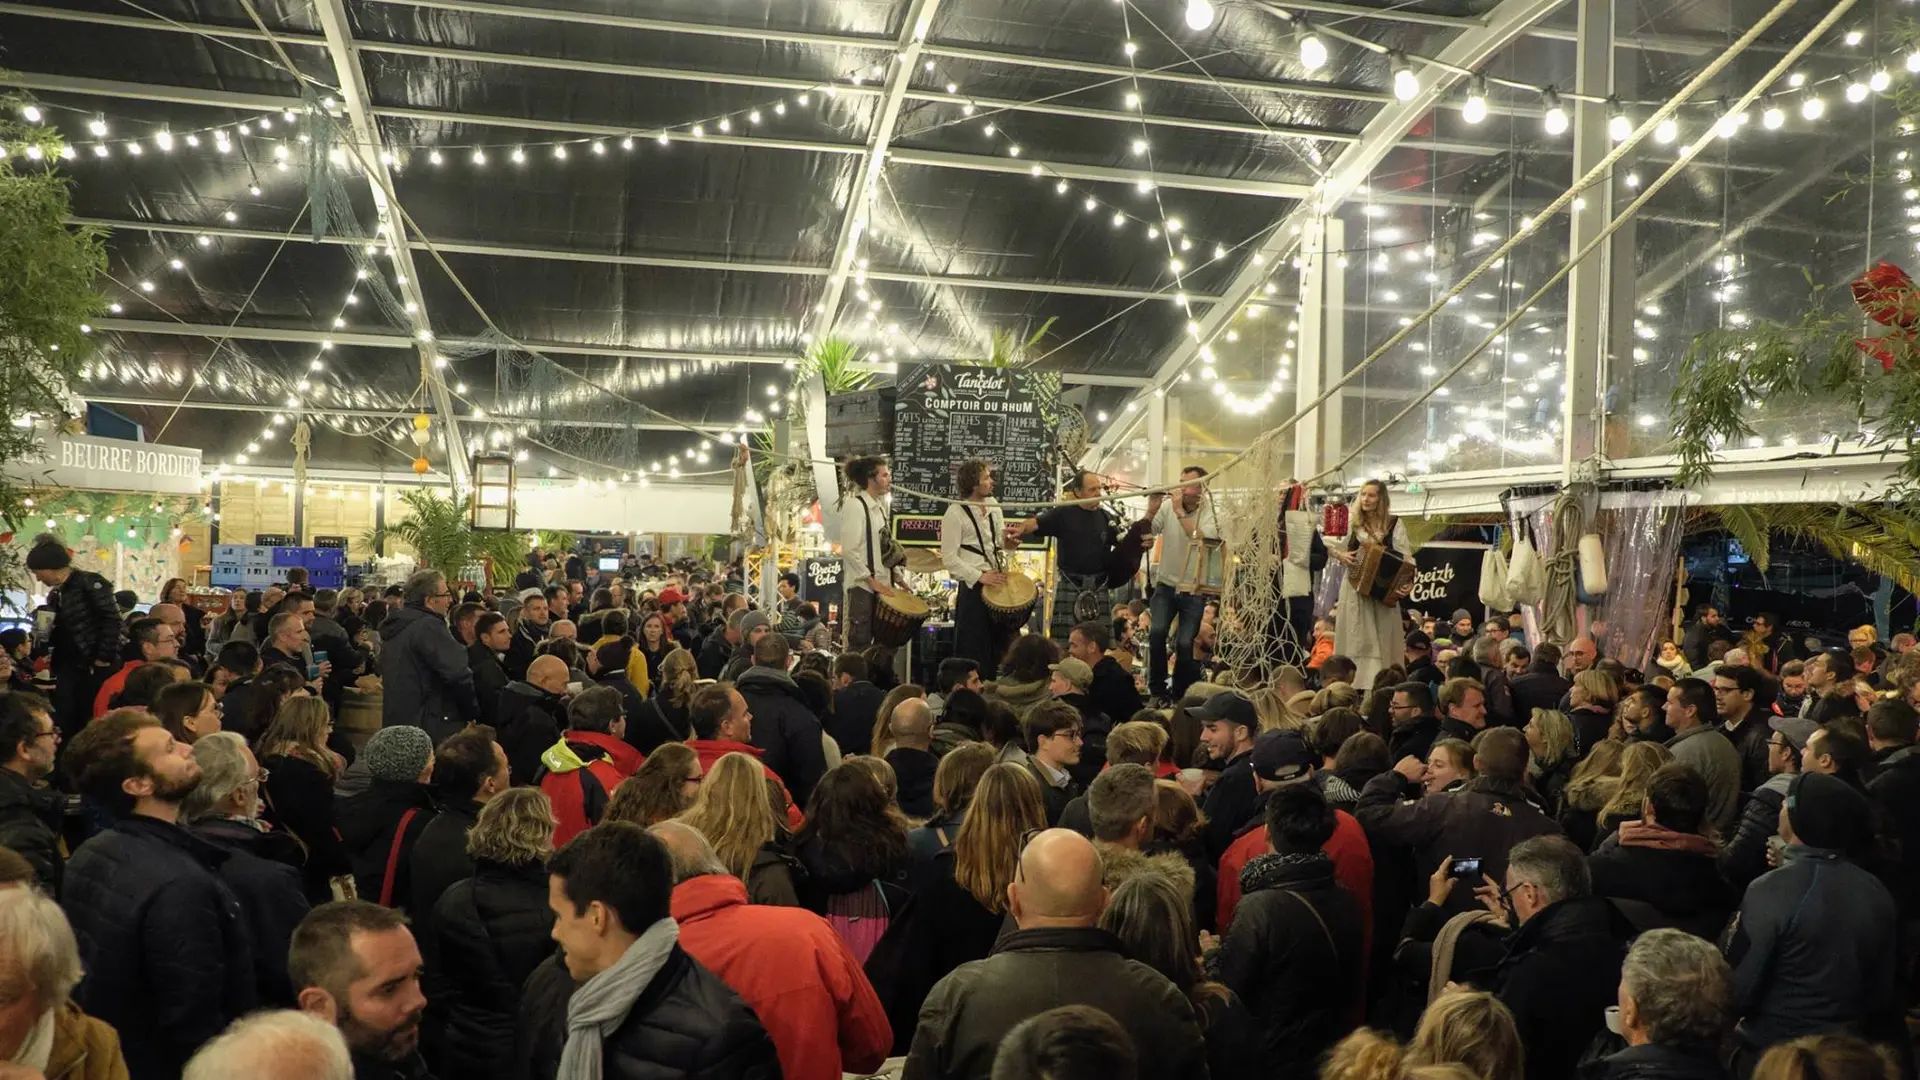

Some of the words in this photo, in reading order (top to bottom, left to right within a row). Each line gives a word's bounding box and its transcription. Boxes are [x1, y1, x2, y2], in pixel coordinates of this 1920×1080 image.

[925, 398, 980, 411] COMPTOIR
[984, 401, 998, 411] DU
[1001, 402, 1033, 413] RHUM
[60, 441, 133, 473] BEURRE
[135, 449, 200, 478] BORDIER
[808, 561, 841, 577] Breizh
[814, 573, 837, 586] Cola
[1410, 582, 1447, 603] Cola
